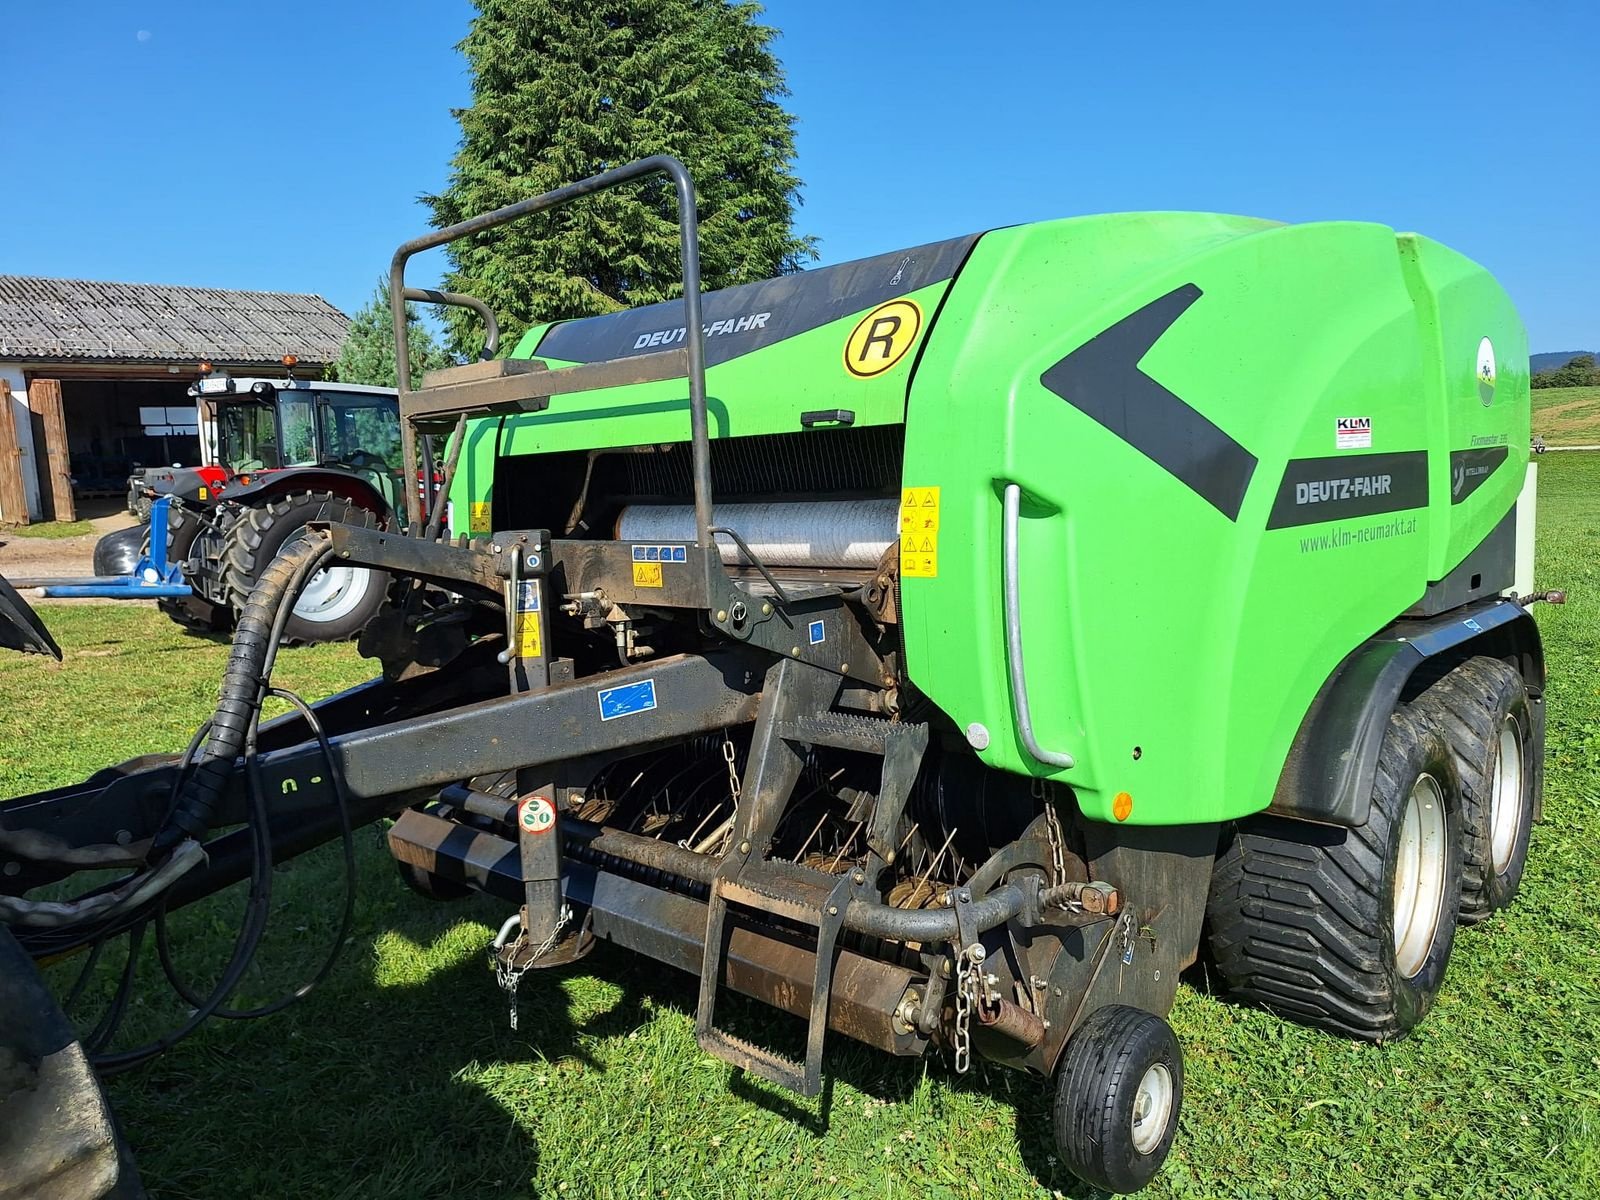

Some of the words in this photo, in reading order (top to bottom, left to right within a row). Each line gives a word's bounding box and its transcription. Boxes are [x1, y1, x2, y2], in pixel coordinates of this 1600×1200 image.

[633, 312, 771, 349] DEUT-FAHR
[858, 315, 900, 362] R
[1337, 418, 1370, 429] KLM
[1296, 474, 1391, 505] DEUTZ-FAHR
[1300, 516, 1417, 554] www.klm-neumarkt.at
